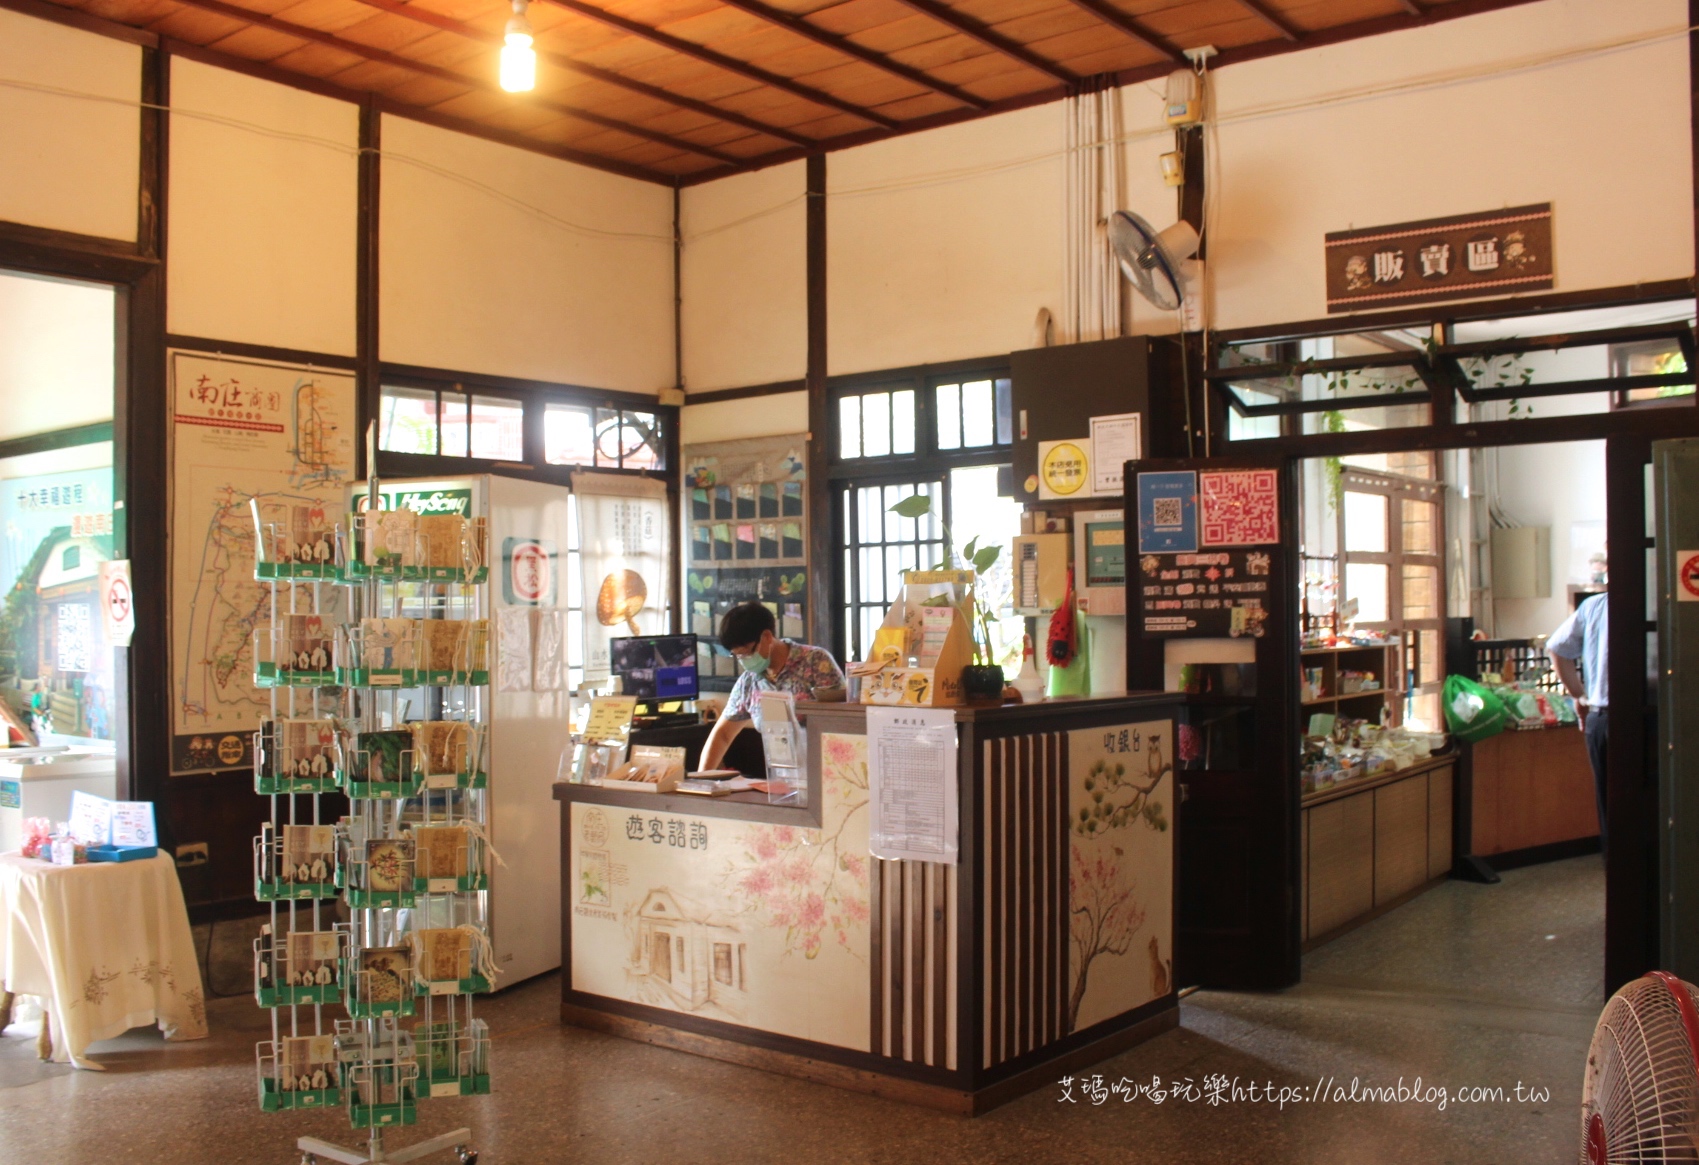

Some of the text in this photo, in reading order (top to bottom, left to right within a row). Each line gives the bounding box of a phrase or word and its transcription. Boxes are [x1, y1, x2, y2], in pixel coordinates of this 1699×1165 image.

[1374, 237, 1500, 283] 販賣區
[189, 374, 281, 412] 南庄商圈
[1103, 728, 1140, 754] 收銀台
[626, 814, 708, 851] 遊客諮詢
